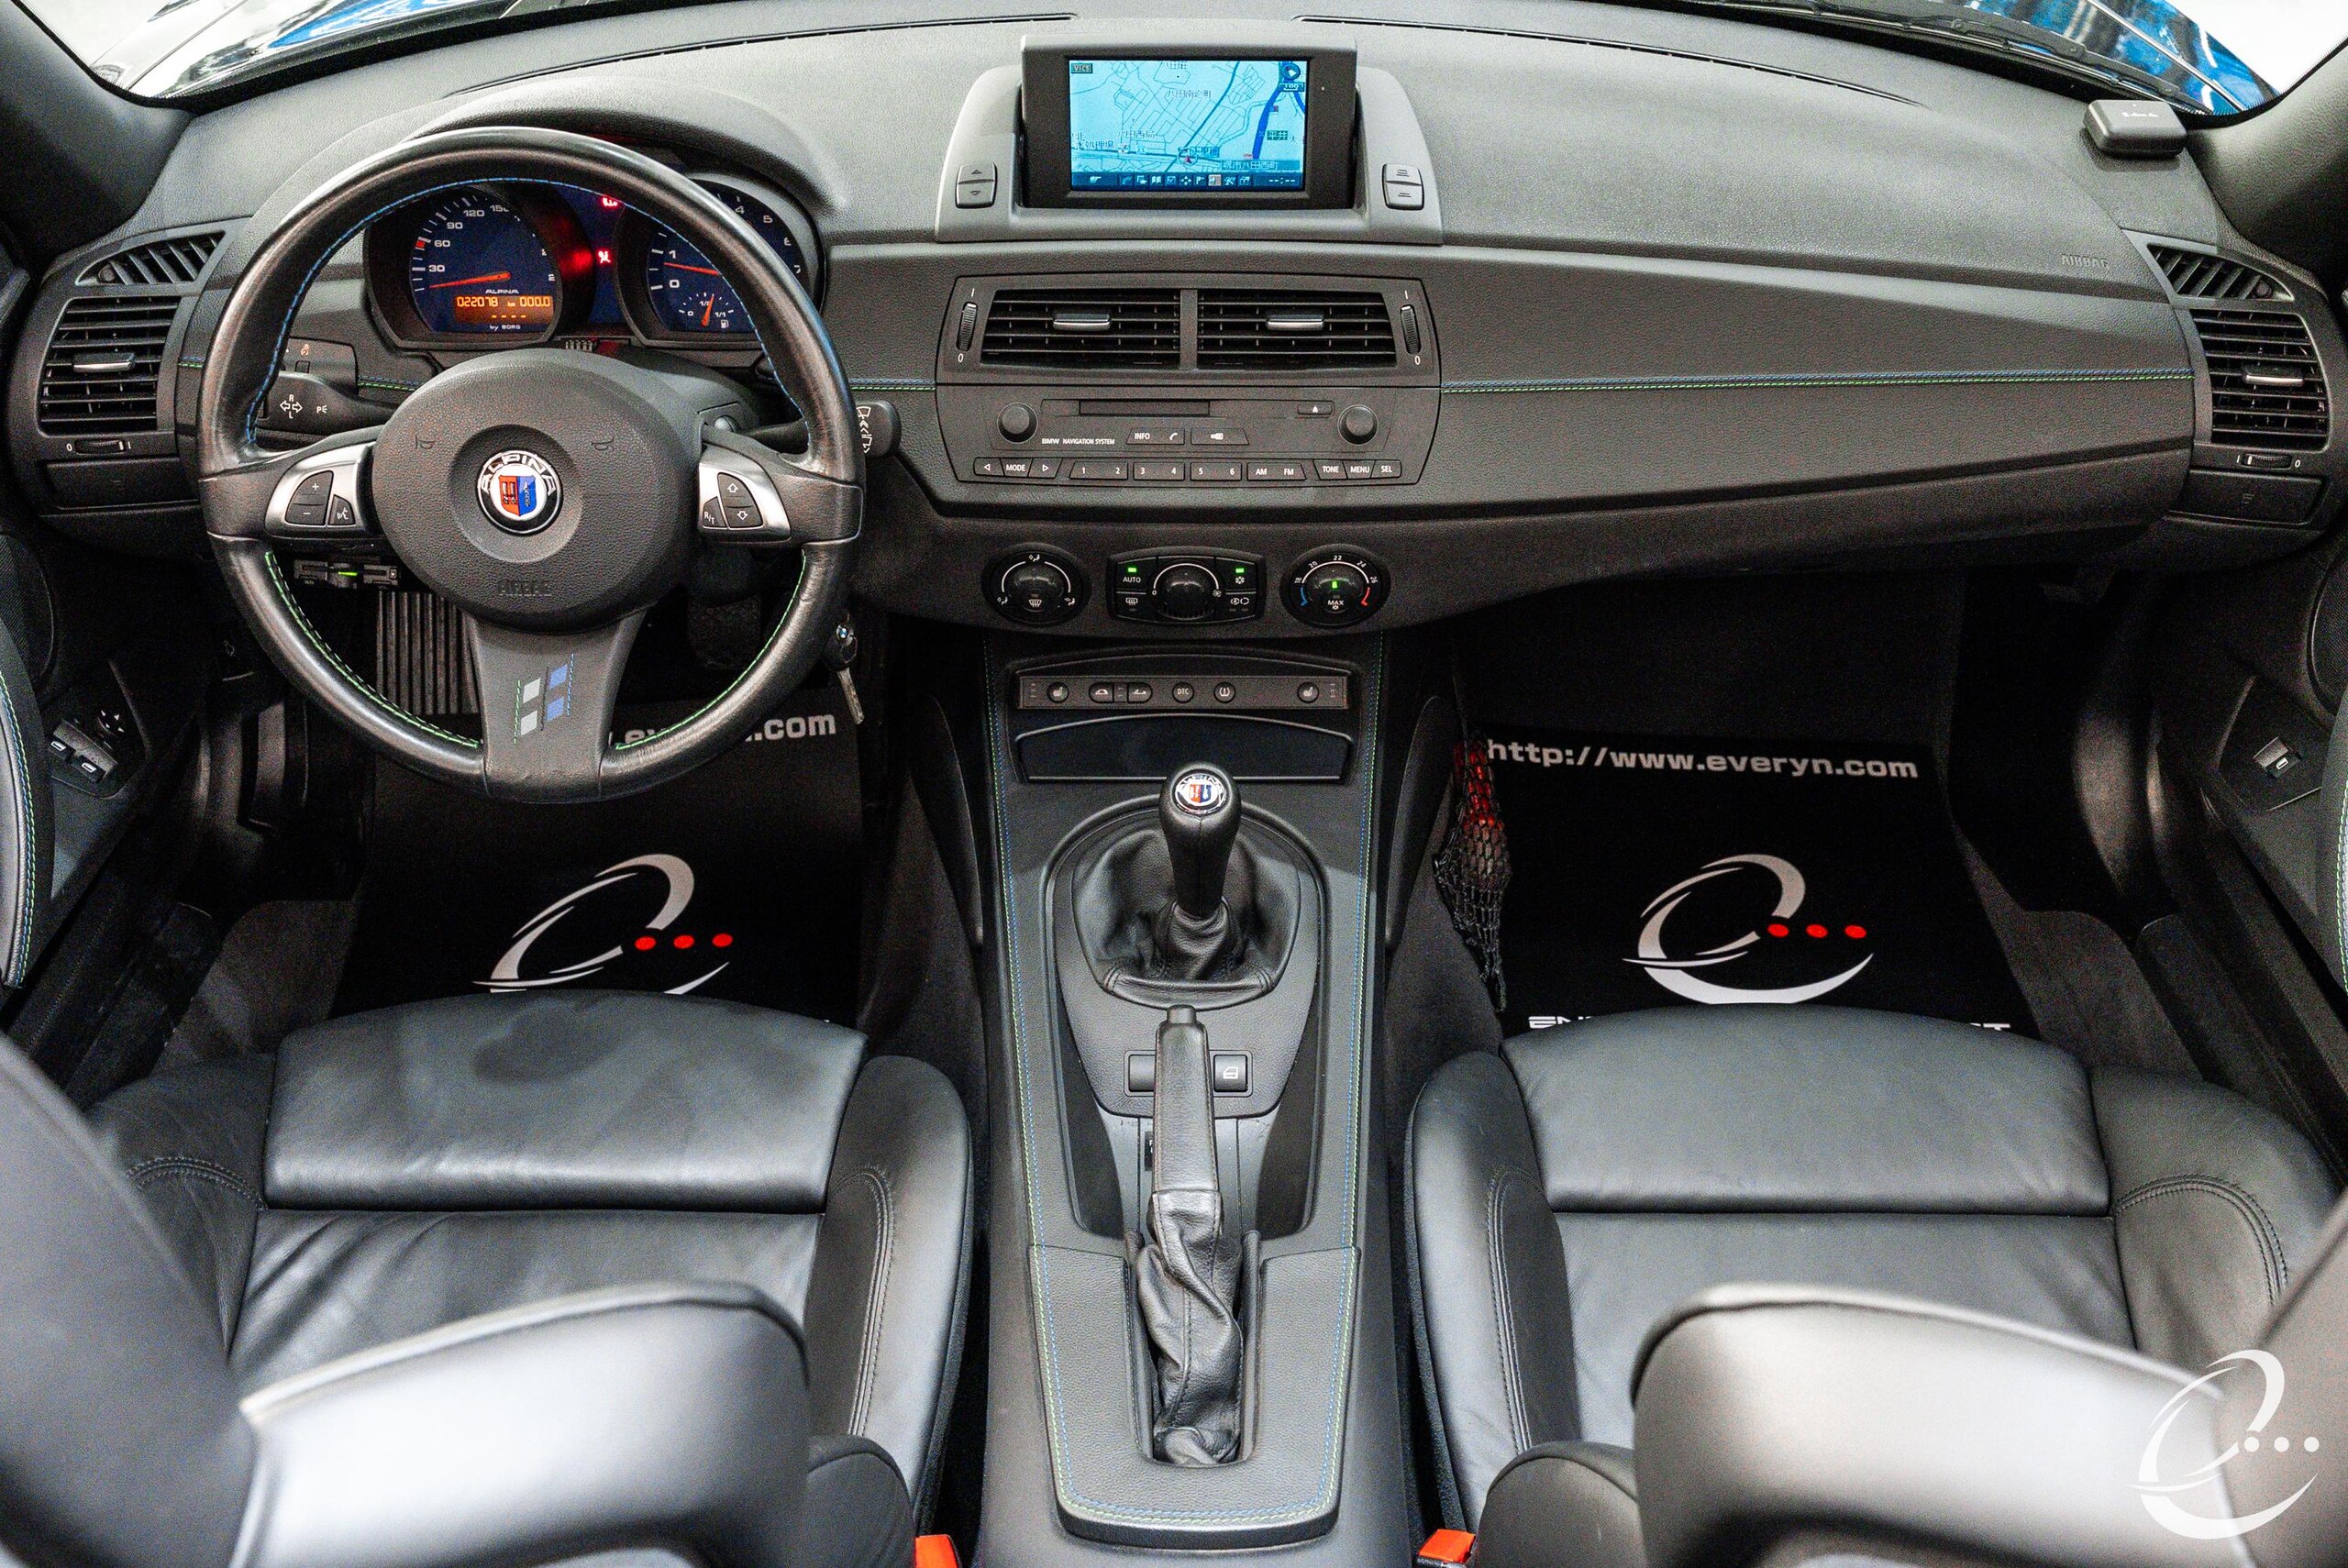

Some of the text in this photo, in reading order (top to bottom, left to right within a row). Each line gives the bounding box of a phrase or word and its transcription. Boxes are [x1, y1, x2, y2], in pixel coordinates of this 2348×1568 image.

[463, 209, 485, 217] 120
[735, 205, 745, 215] 4
[763, 215, 773, 224] 5
[434, 239, 450, 248] 60
[669, 249, 676, 259] 1
[428, 264, 445, 272] 30
[669, 279, 680, 288] 0
[456, 296, 499, 307] 022078
[289, 393, 294, 402] R
[288, 411, 294, 419] L
[481, 453, 557, 497] ALPINA
[1140, 467, 1146, 475] 3
[1171, 467, 1177, 475] 4
[1198, 467, 1203, 475] 5
[1230, 467, 1235, 475] 6
[703, 511, 715, 525] R/T
[1308, 560, 1318, 569] 20
[1357, 560, 1367, 569] 24
[1488, 738, 1919, 778] http://www.everyn.com
